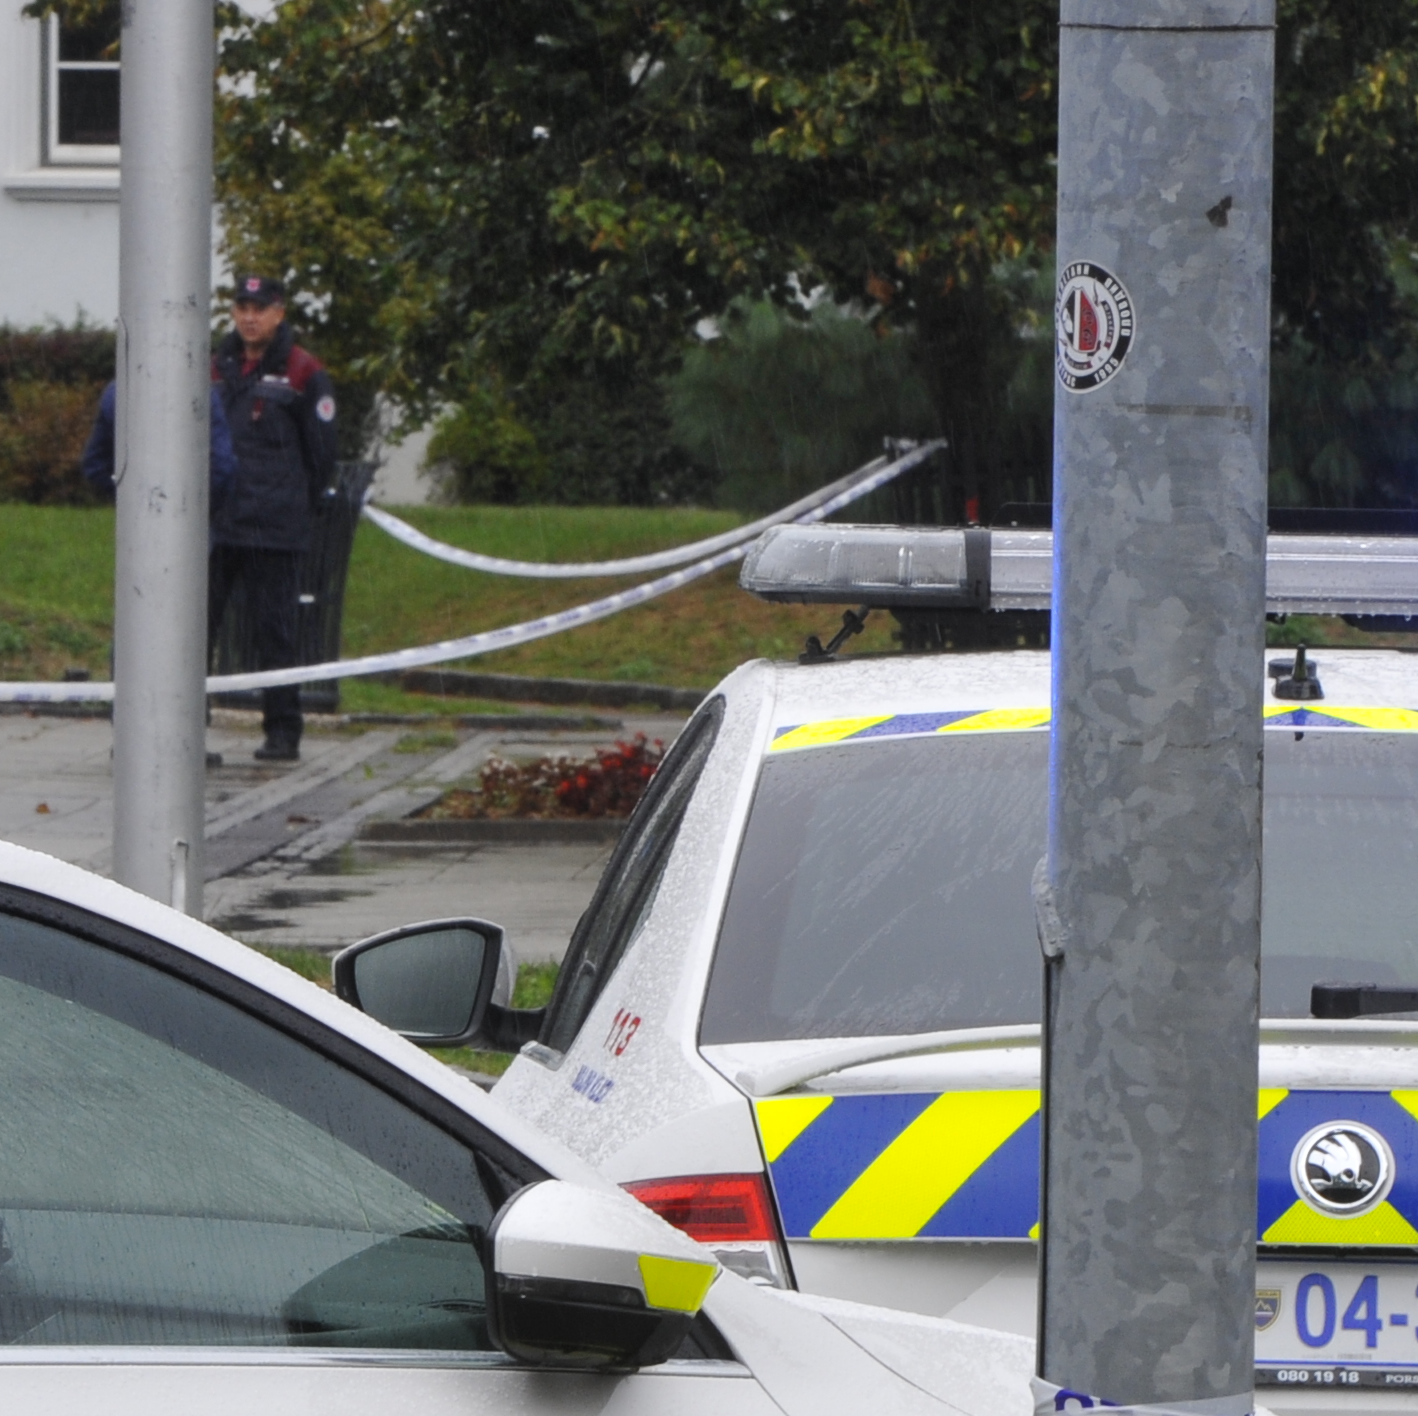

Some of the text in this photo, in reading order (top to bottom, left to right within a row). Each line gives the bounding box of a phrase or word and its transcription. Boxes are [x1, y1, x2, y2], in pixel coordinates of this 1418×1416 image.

[1277, 1369, 1360, 1384] 080 19 18
